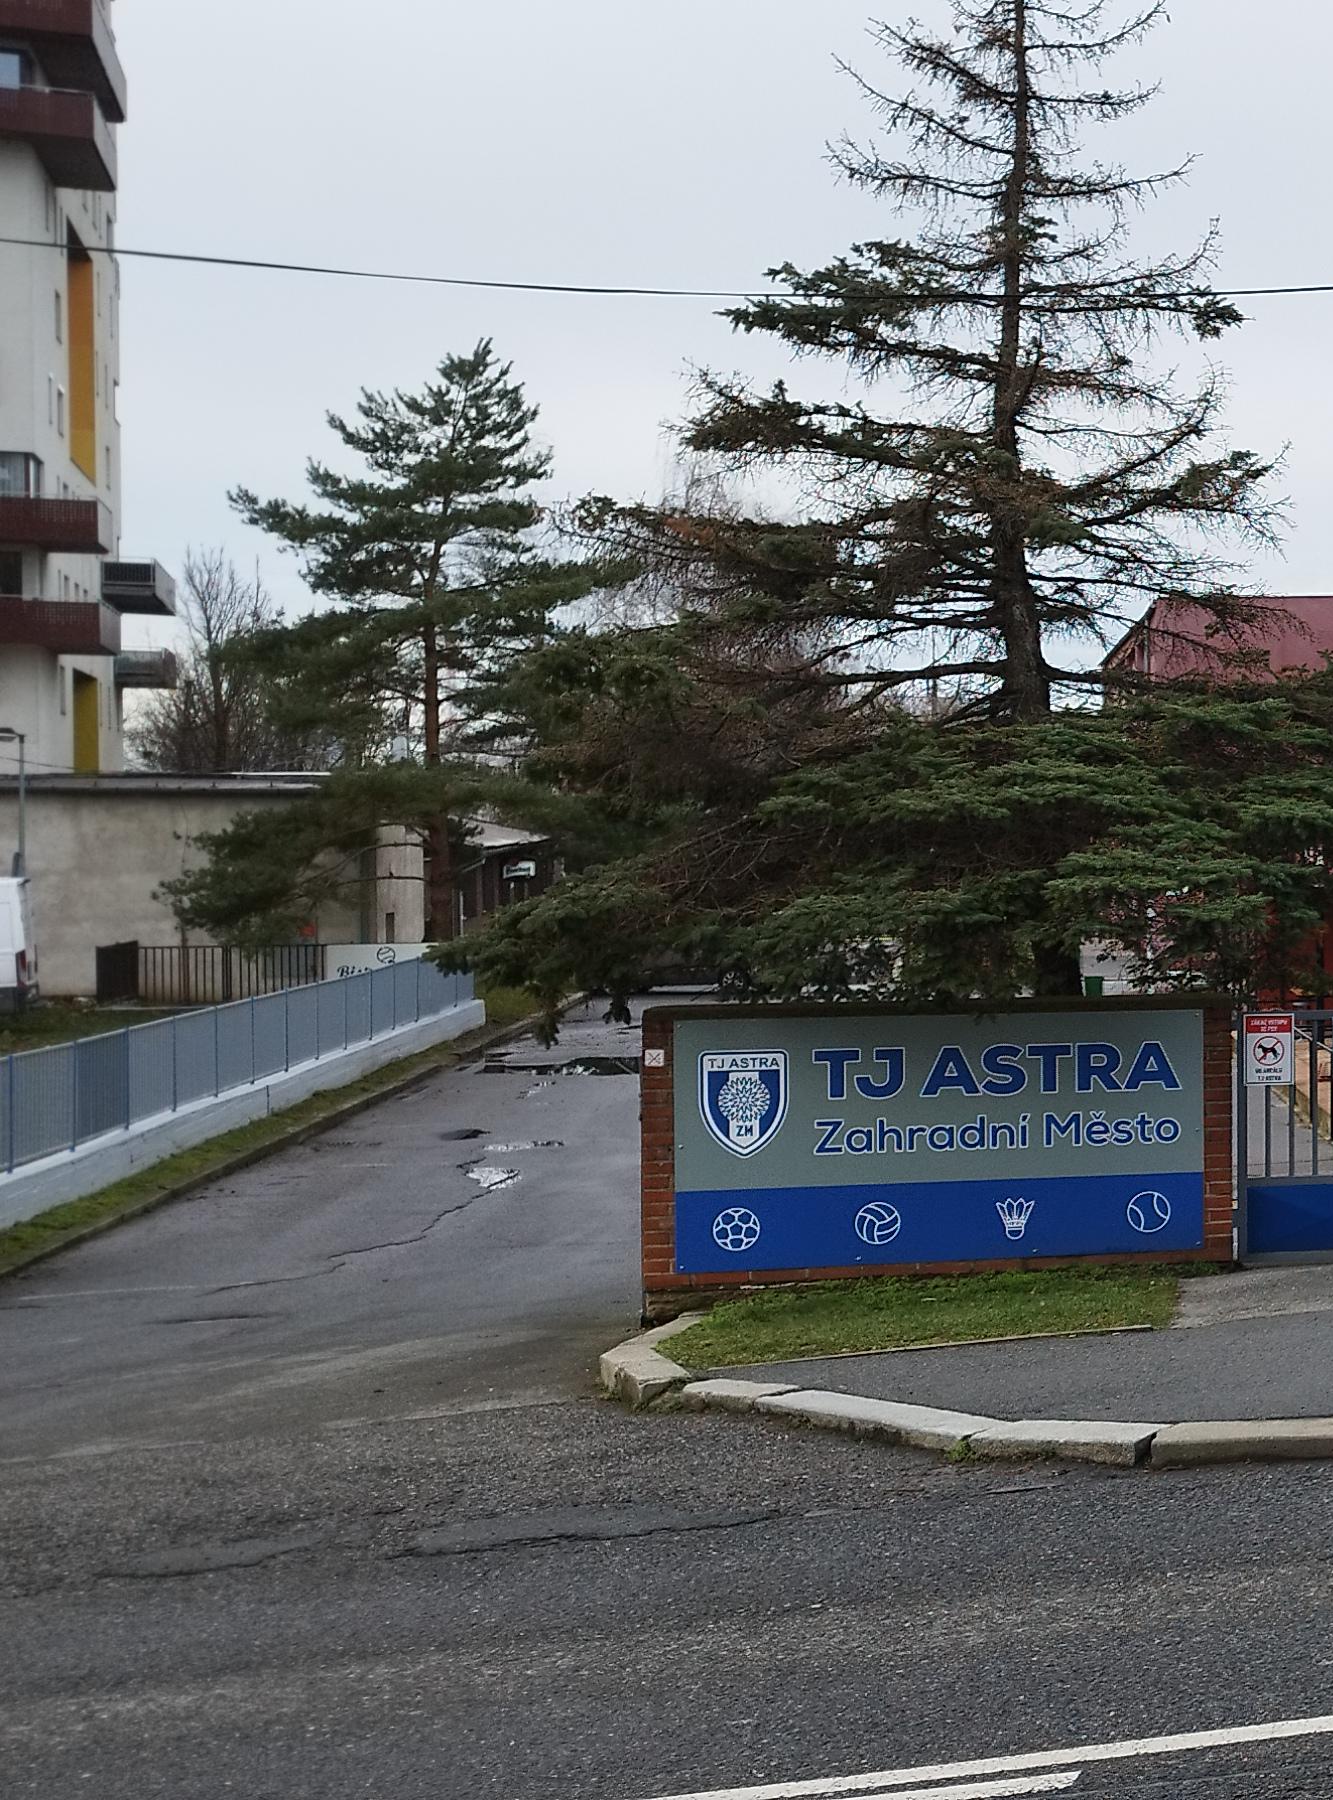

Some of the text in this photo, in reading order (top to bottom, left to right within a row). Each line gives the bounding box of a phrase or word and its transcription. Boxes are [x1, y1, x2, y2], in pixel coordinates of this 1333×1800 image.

[707, 1057, 780, 1069] TJ ASTRA
[812, 1041, 1182, 1100] TJ ASTRA
[814, 1111, 1182, 1155] Zahradní Město
